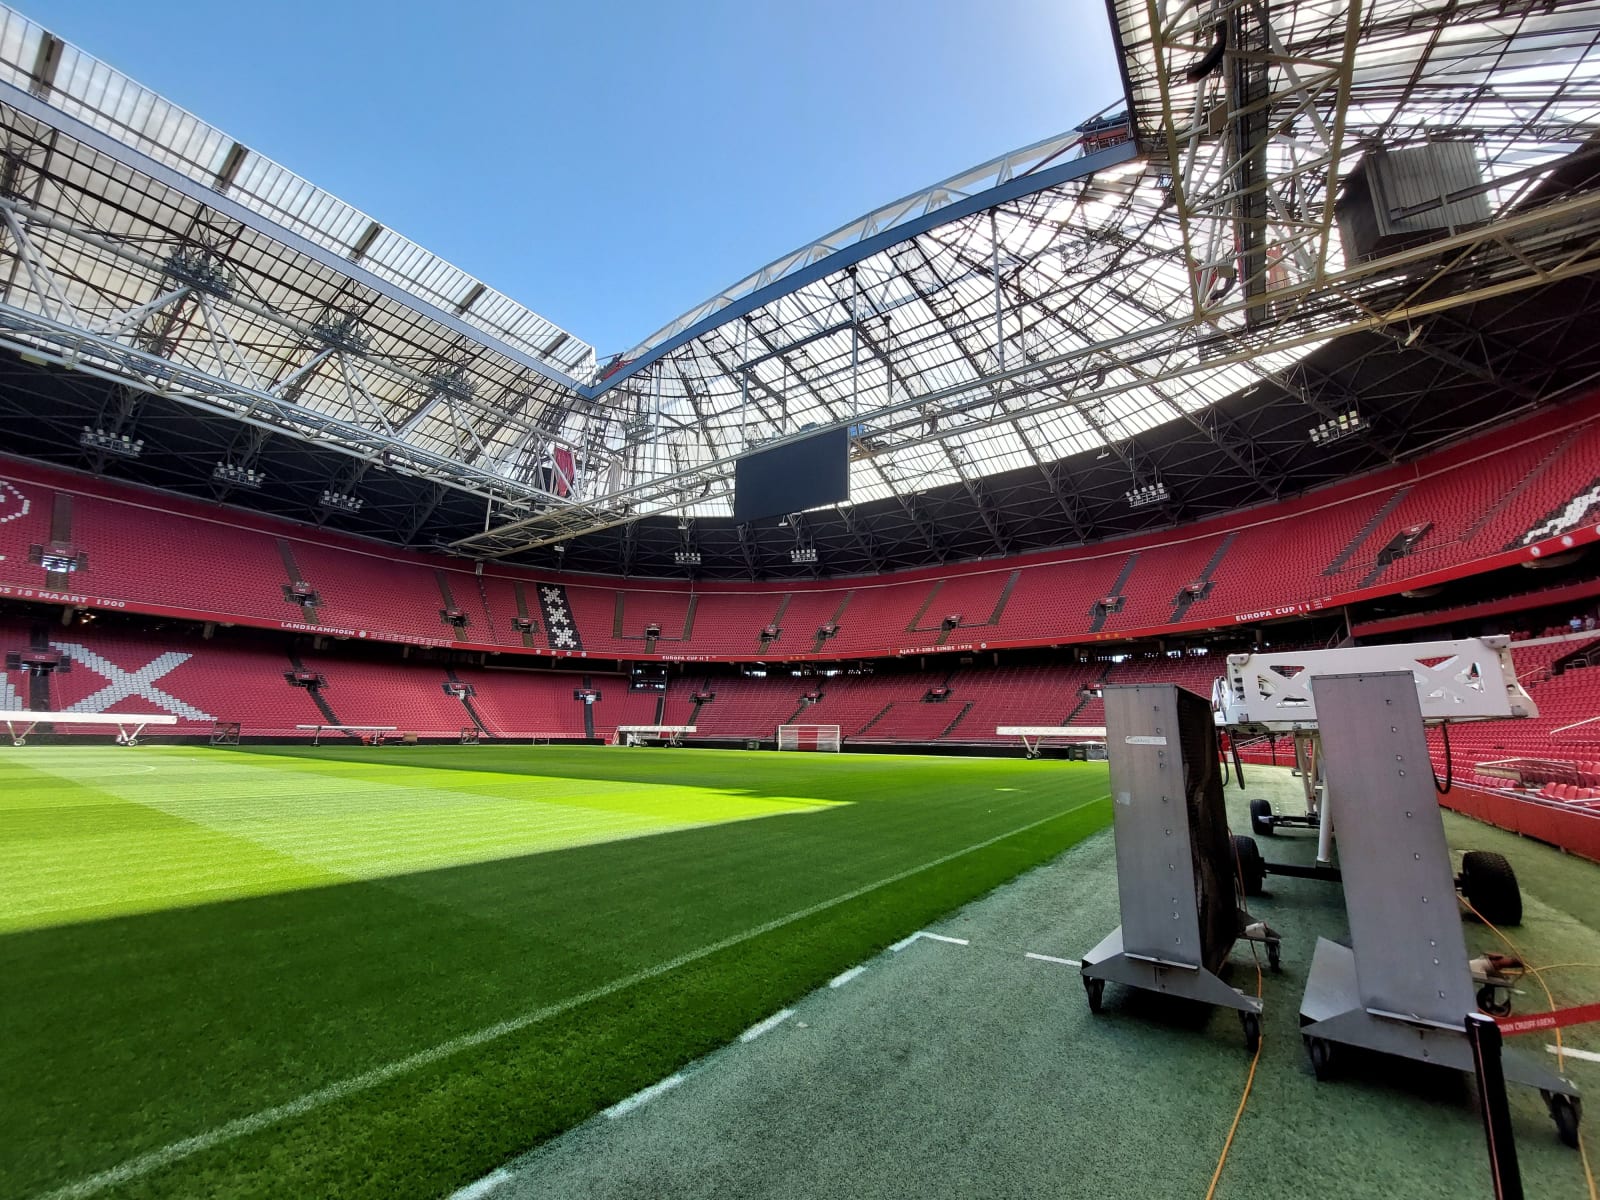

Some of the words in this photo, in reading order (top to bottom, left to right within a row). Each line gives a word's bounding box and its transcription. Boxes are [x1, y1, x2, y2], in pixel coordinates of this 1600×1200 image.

[17, 588, 33, 597] 18
[38, 591, 88, 603] MAART
[96, 599, 125, 608] 1900
[1235, 610, 1272, 622] EUROPA
[1275, 606, 1295, 615] CUP
[281, 621, 355, 636] LANDSKAMPIOEN
